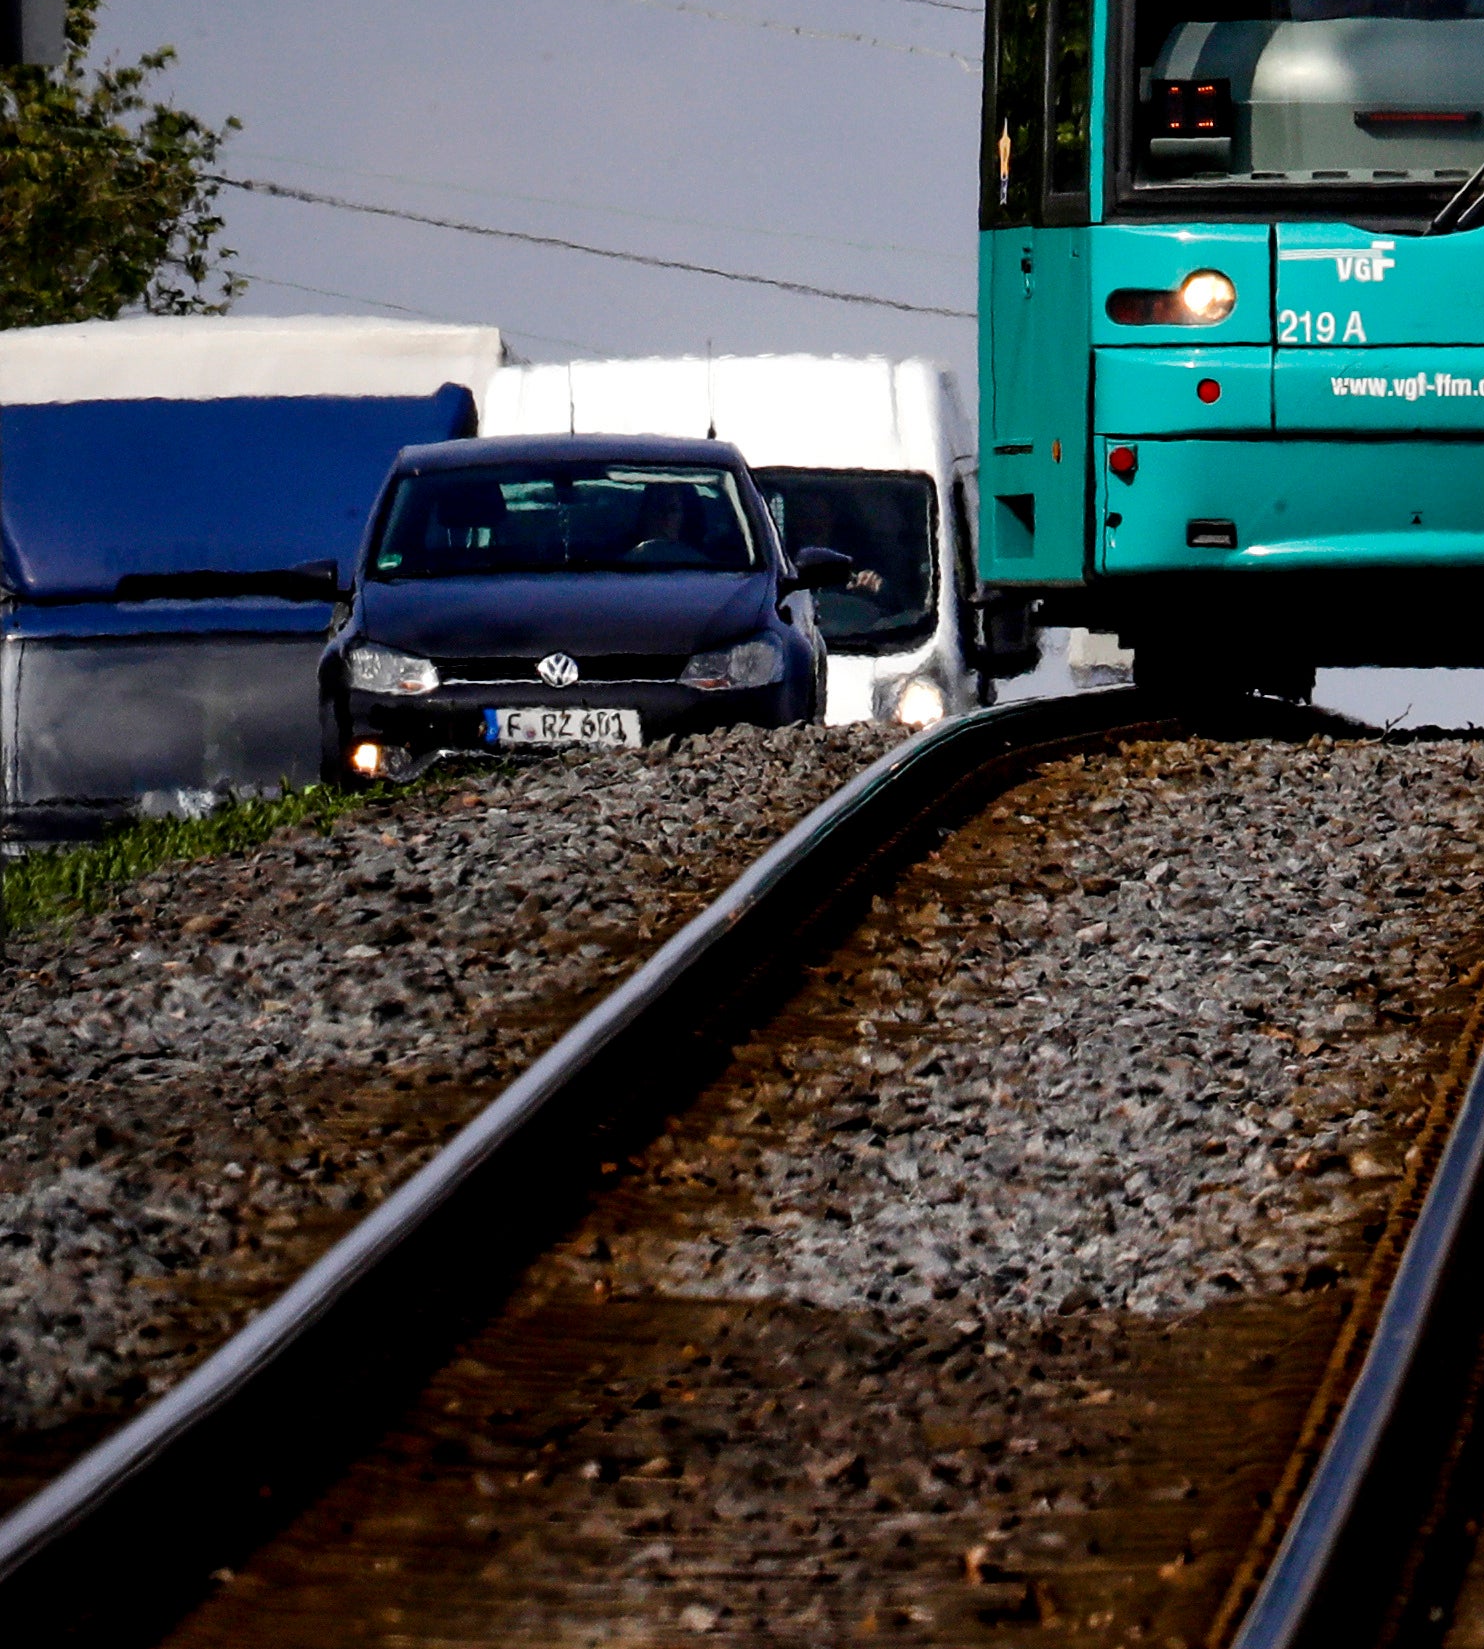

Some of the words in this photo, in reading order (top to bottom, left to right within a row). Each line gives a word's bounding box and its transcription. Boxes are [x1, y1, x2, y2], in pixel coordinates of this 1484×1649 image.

[1336, 240, 1396, 283] VGF
[1279, 309, 1336, 344] 219
[1342, 310, 1367, 343] A
[507, 712, 522, 738] F
